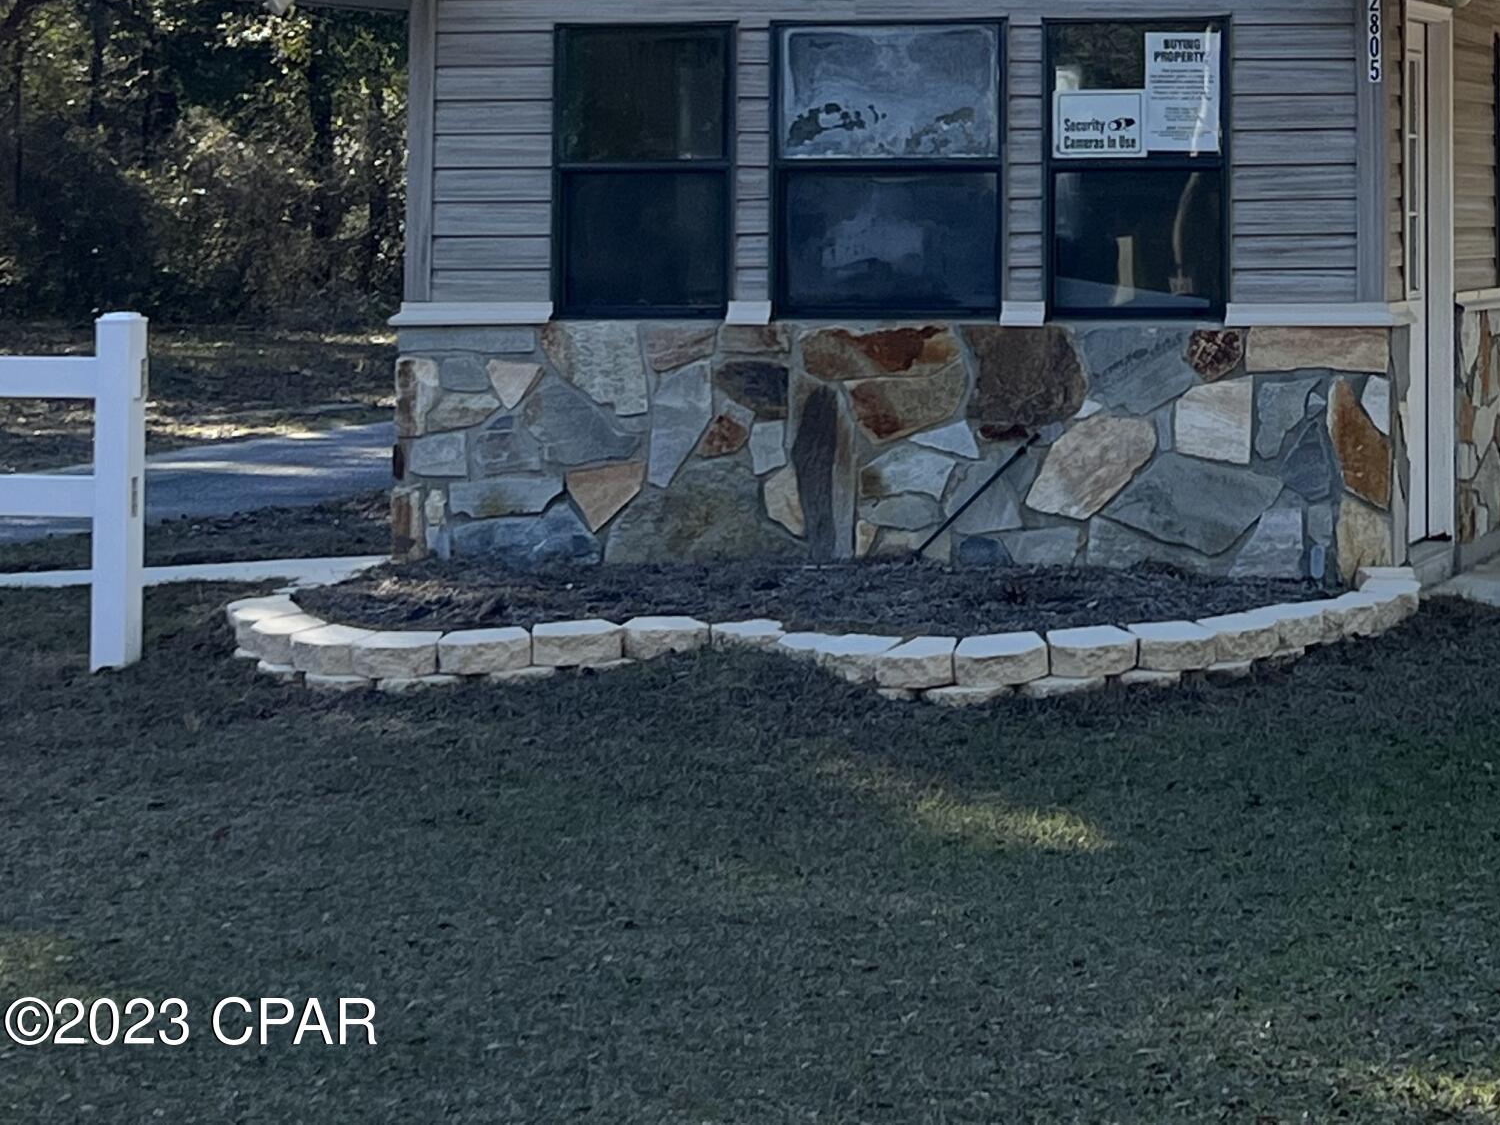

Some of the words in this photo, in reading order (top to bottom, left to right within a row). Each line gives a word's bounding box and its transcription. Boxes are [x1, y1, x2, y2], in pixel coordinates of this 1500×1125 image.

[1163, 38, 1201, 50] BUYING
[1153, 50, 1206, 63] PROPERTY
[1063, 117, 1105, 134] Security
[1063, 135, 1105, 149] Cameras
[1118, 134, 1137, 149] Use
